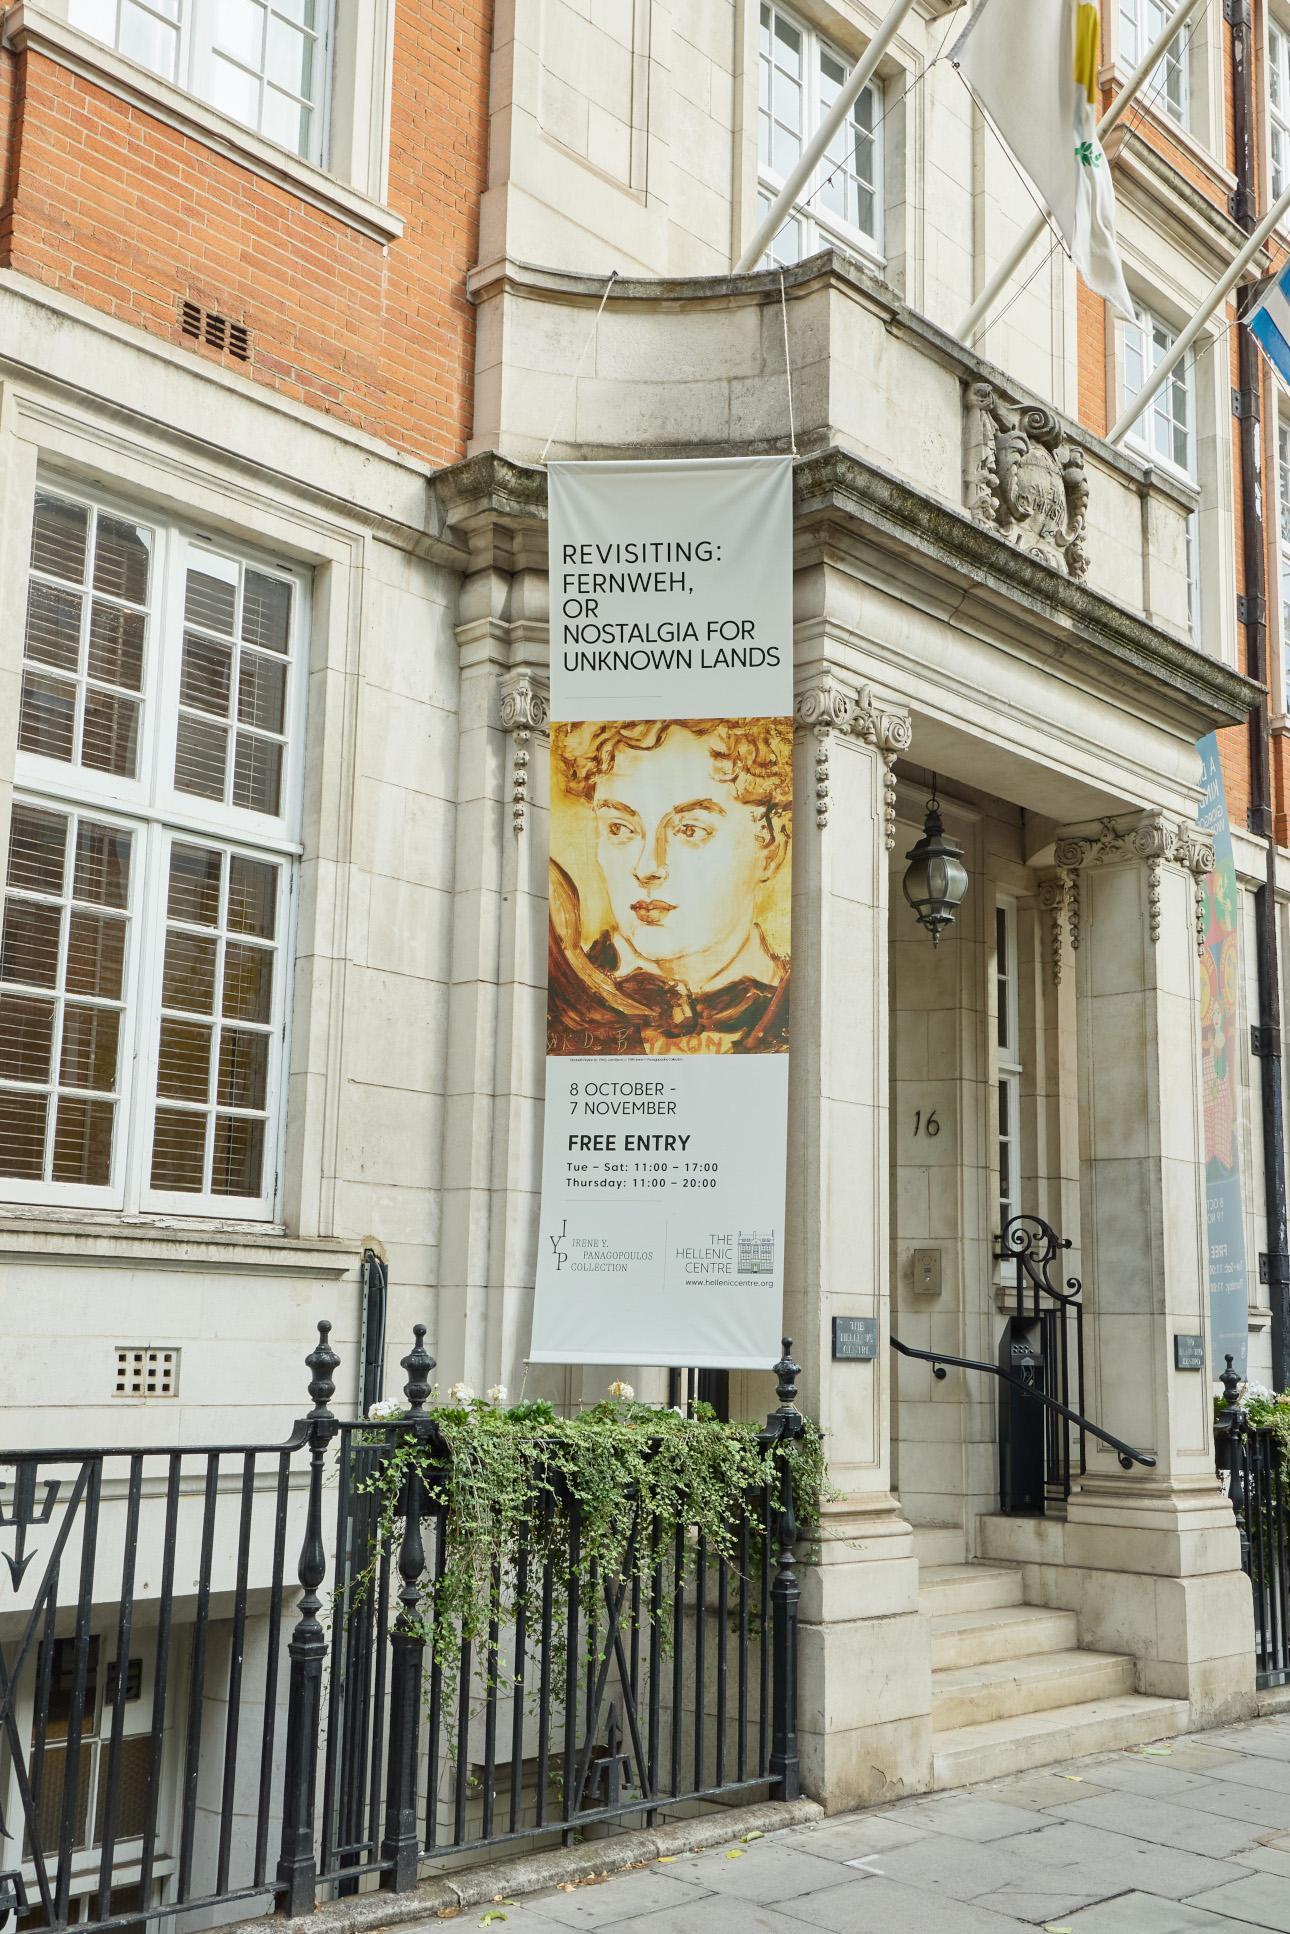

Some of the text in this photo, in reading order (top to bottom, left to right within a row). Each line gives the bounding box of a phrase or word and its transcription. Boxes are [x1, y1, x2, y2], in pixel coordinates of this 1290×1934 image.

[563, 540, 721, 565] REVISITING:
[563, 571, 693, 595] FERNWEH,
[562, 598, 599, 619] OR
[563, 619, 755, 645] NOSTALGIA FOR
[563, 646, 781, 672] UNKNOWN LANDS
[569, 1082, 579, 1097] 8
[584, 1082, 664, 1097] OCTOBER
[569, 1101, 677, 1115] 7 NOVEMBER
[914, 1109, 941, 1138] 16
[568, 1134, 691, 1152] FREE ENTRY
[566, 1162, 588, 1172] Tue
[604, 1162, 628, 1172] Sat:
[634, 1162, 668, 1172] 11:00
[684, 1162, 718, 1172] 17:00
[565, 1177, 627, 1190] Thursday:
[633, 1178, 666, 1188] 11:00
[682, 1178, 717, 1188] 20:00
[572, 1238, 599, 1248] IRENE
[711, 1234, 733, 1246] THE
[583, 1250, 654, 1261] PANAGOPOULOS
[676, 1247, 733, 1260] HELLENIC
[570, 1262, 628, 1272] COLLECTION
[685, 1262, 733, 1274] CENTRE
[685, 1279, 774, 1289] www.helleniccentre.org
